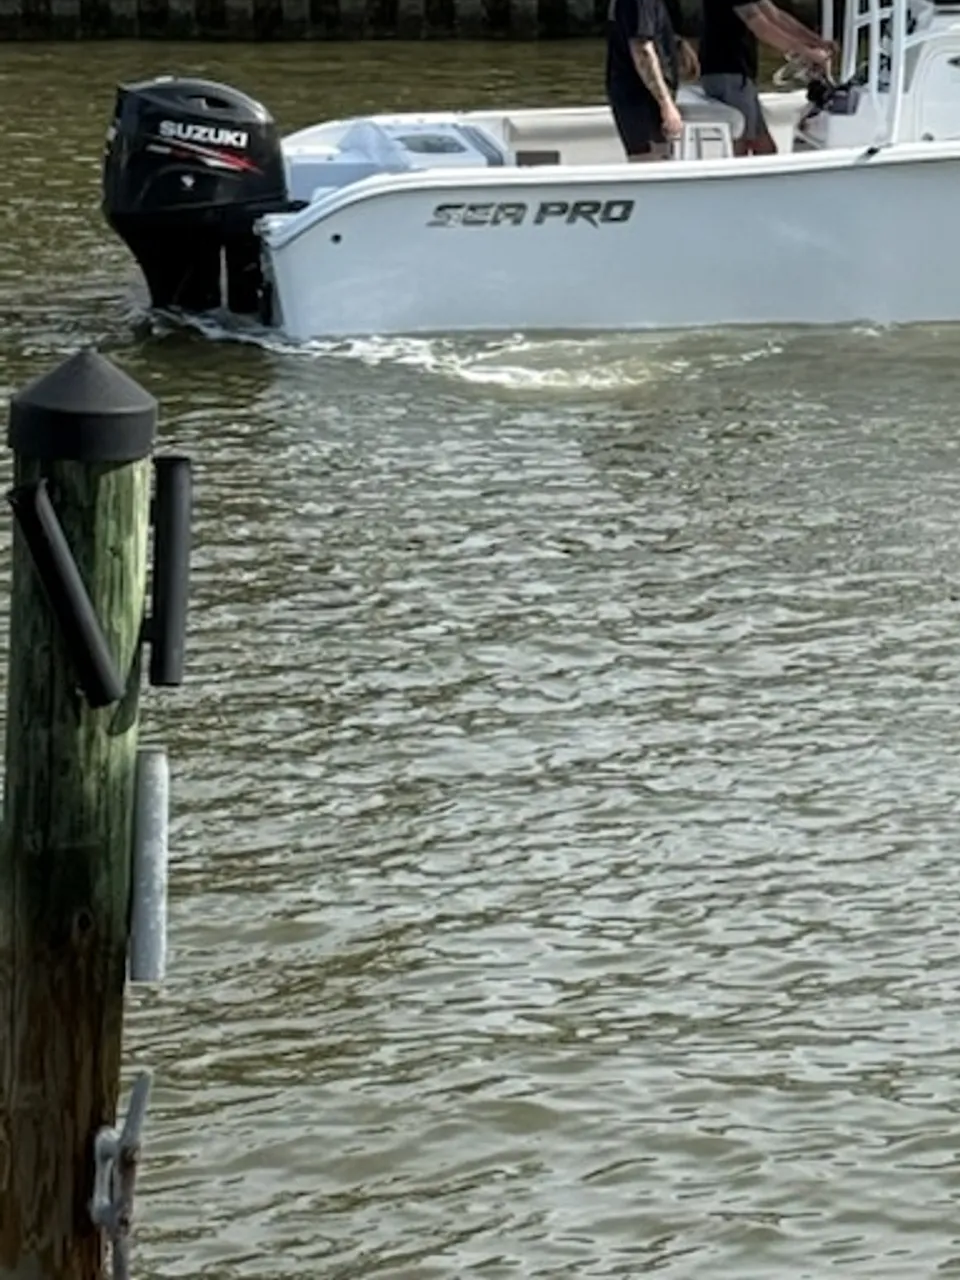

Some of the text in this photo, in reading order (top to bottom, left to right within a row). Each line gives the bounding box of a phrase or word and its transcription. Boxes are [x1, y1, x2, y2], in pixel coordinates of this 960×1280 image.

[159, 120, 248, 148] SUZUKI
[426, 200, 635, 228] SEA PRO
